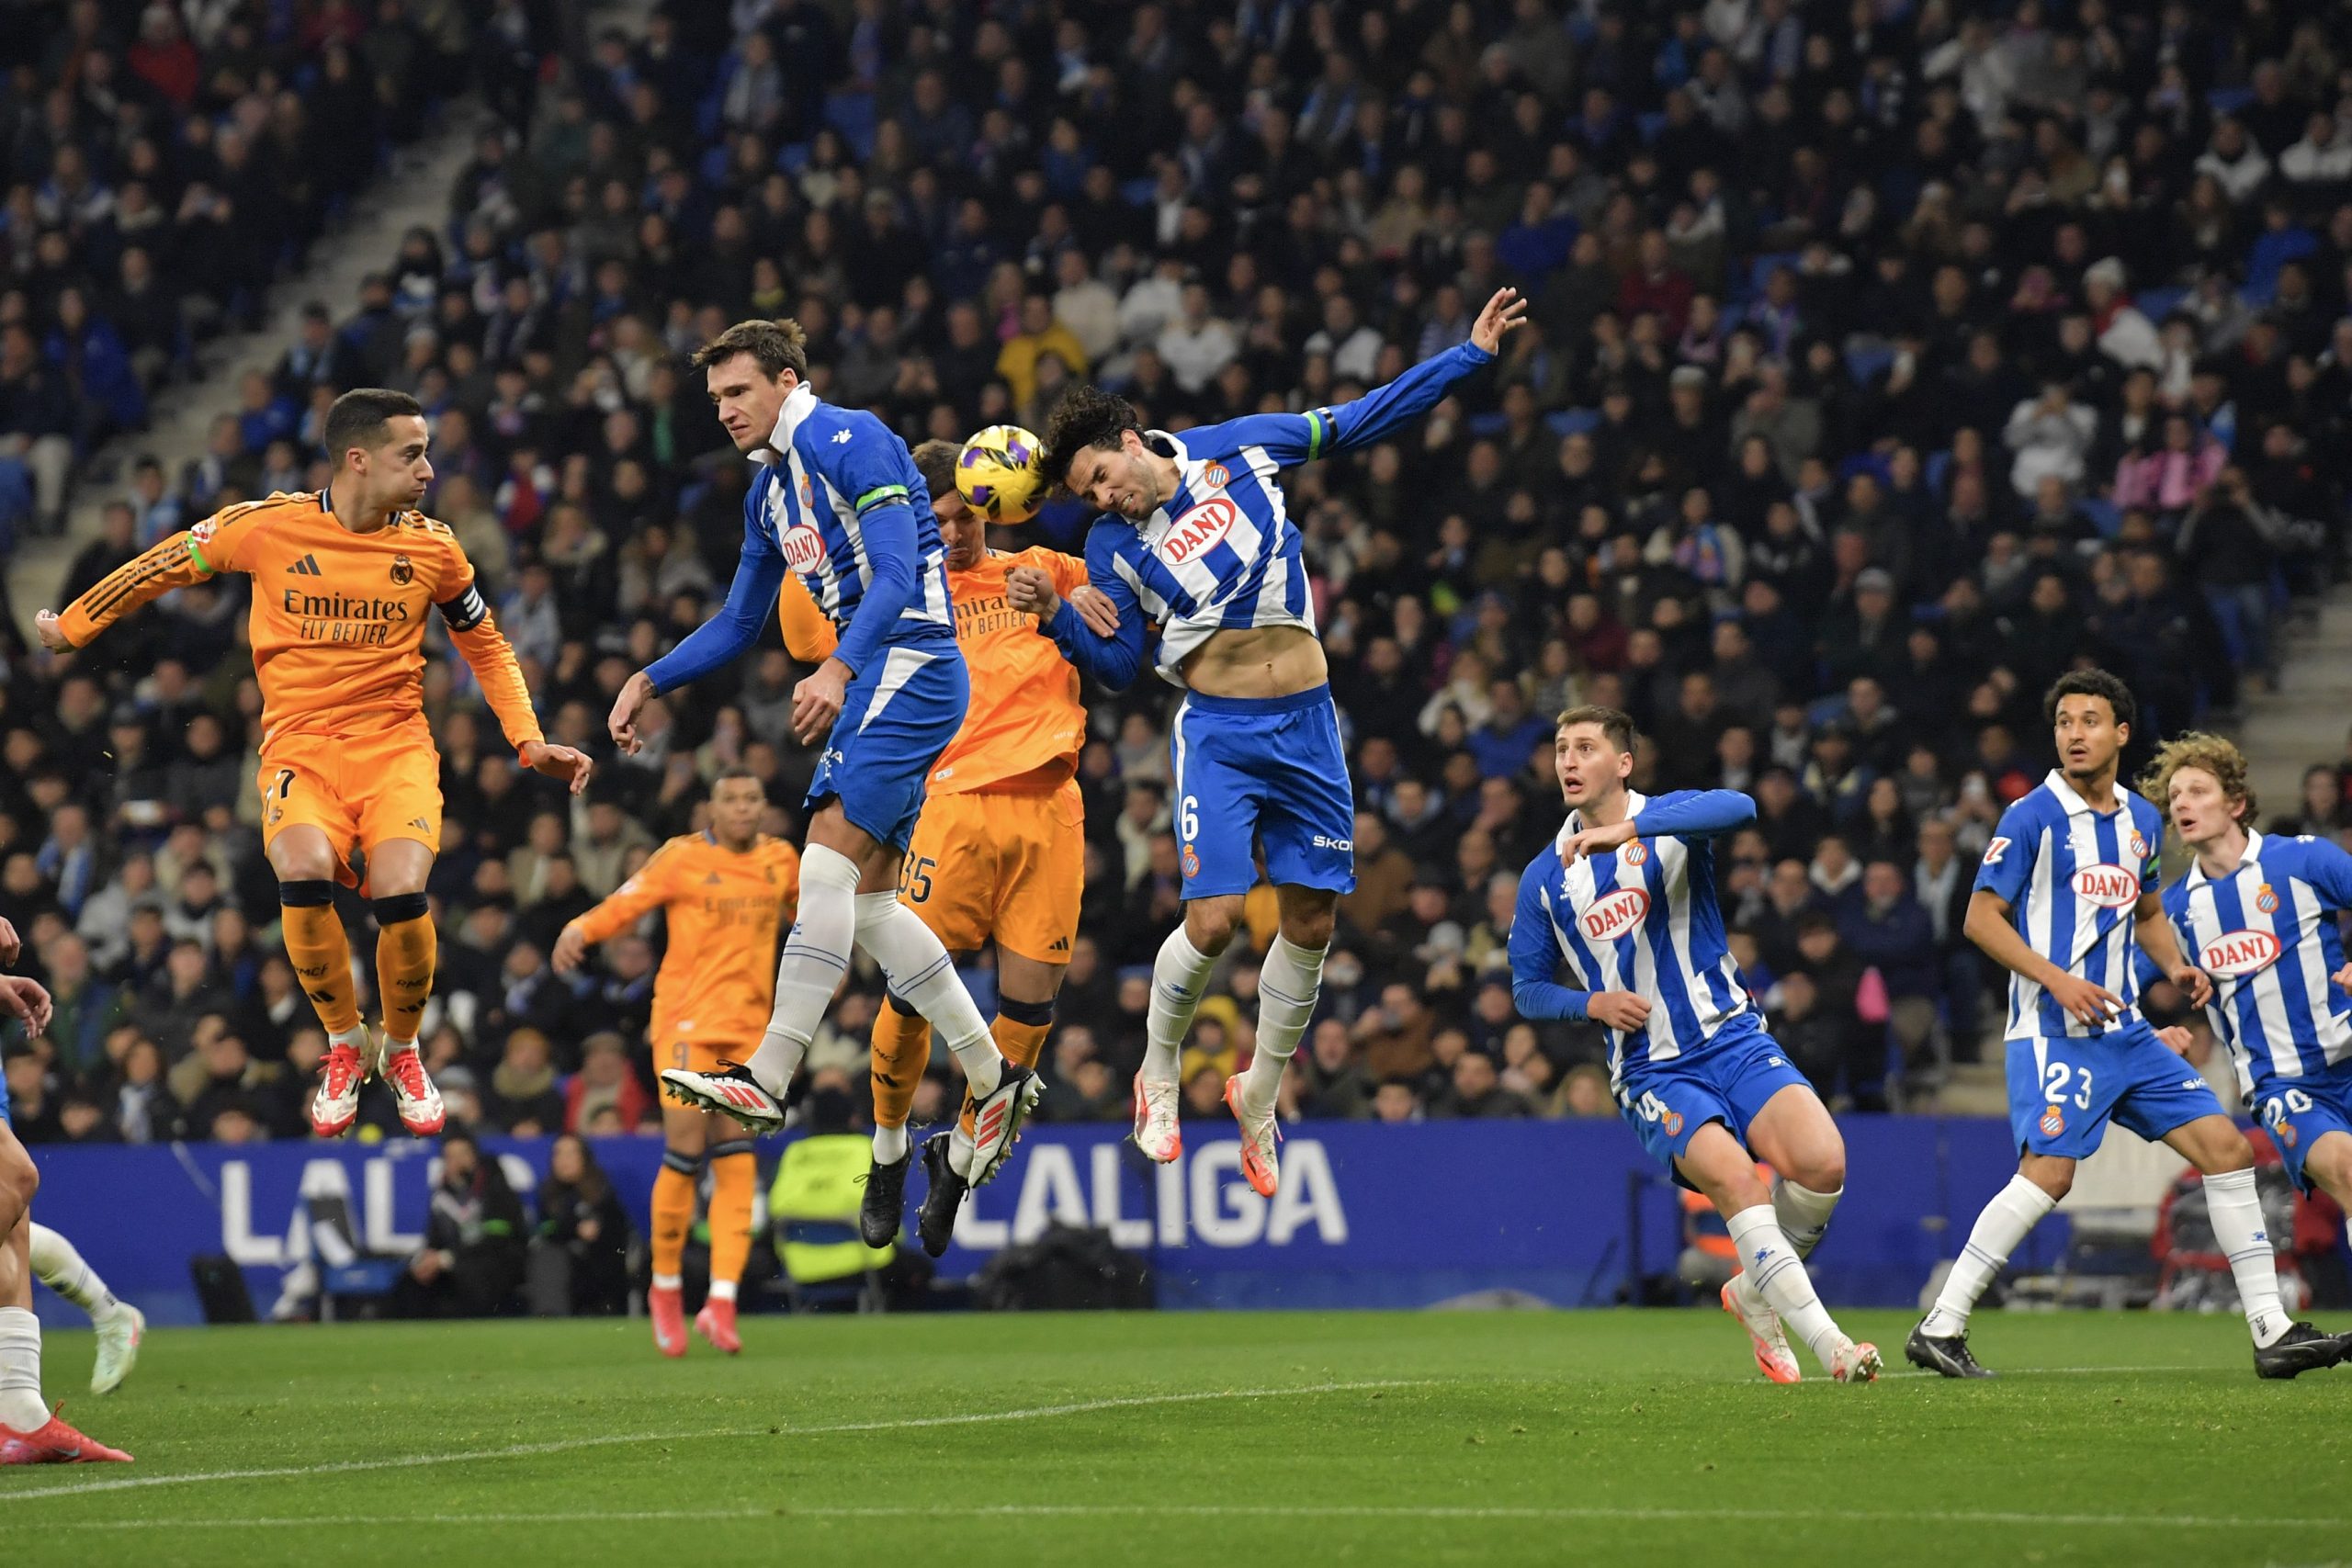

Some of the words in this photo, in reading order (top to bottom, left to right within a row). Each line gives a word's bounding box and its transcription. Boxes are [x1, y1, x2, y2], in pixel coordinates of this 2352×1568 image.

[783, 534, 817, 566] DANI
[1164, 506, 1226, 562] DANI
[284, 589, 408, 621] Emirates
[300, 619, 327, 640] FLY
[332, 622, 388, 645] BETTER
[958, 620, 971, 640] LY
[978, 610, 1026, 635] BETTER
[1181, 795, 1199, 841] 6
[1313, 834, 1352, 852] SKO
[897, 850, 936, 903] 35
[2081, 873, 2129, 898] DANI
[1585, 894, 1638, 938] DANI
[2207, 937, 2267, 969] DANI
[2045, 1062, 2092, 1110] 23
[2264, 1089, 2312, 1128] 20
